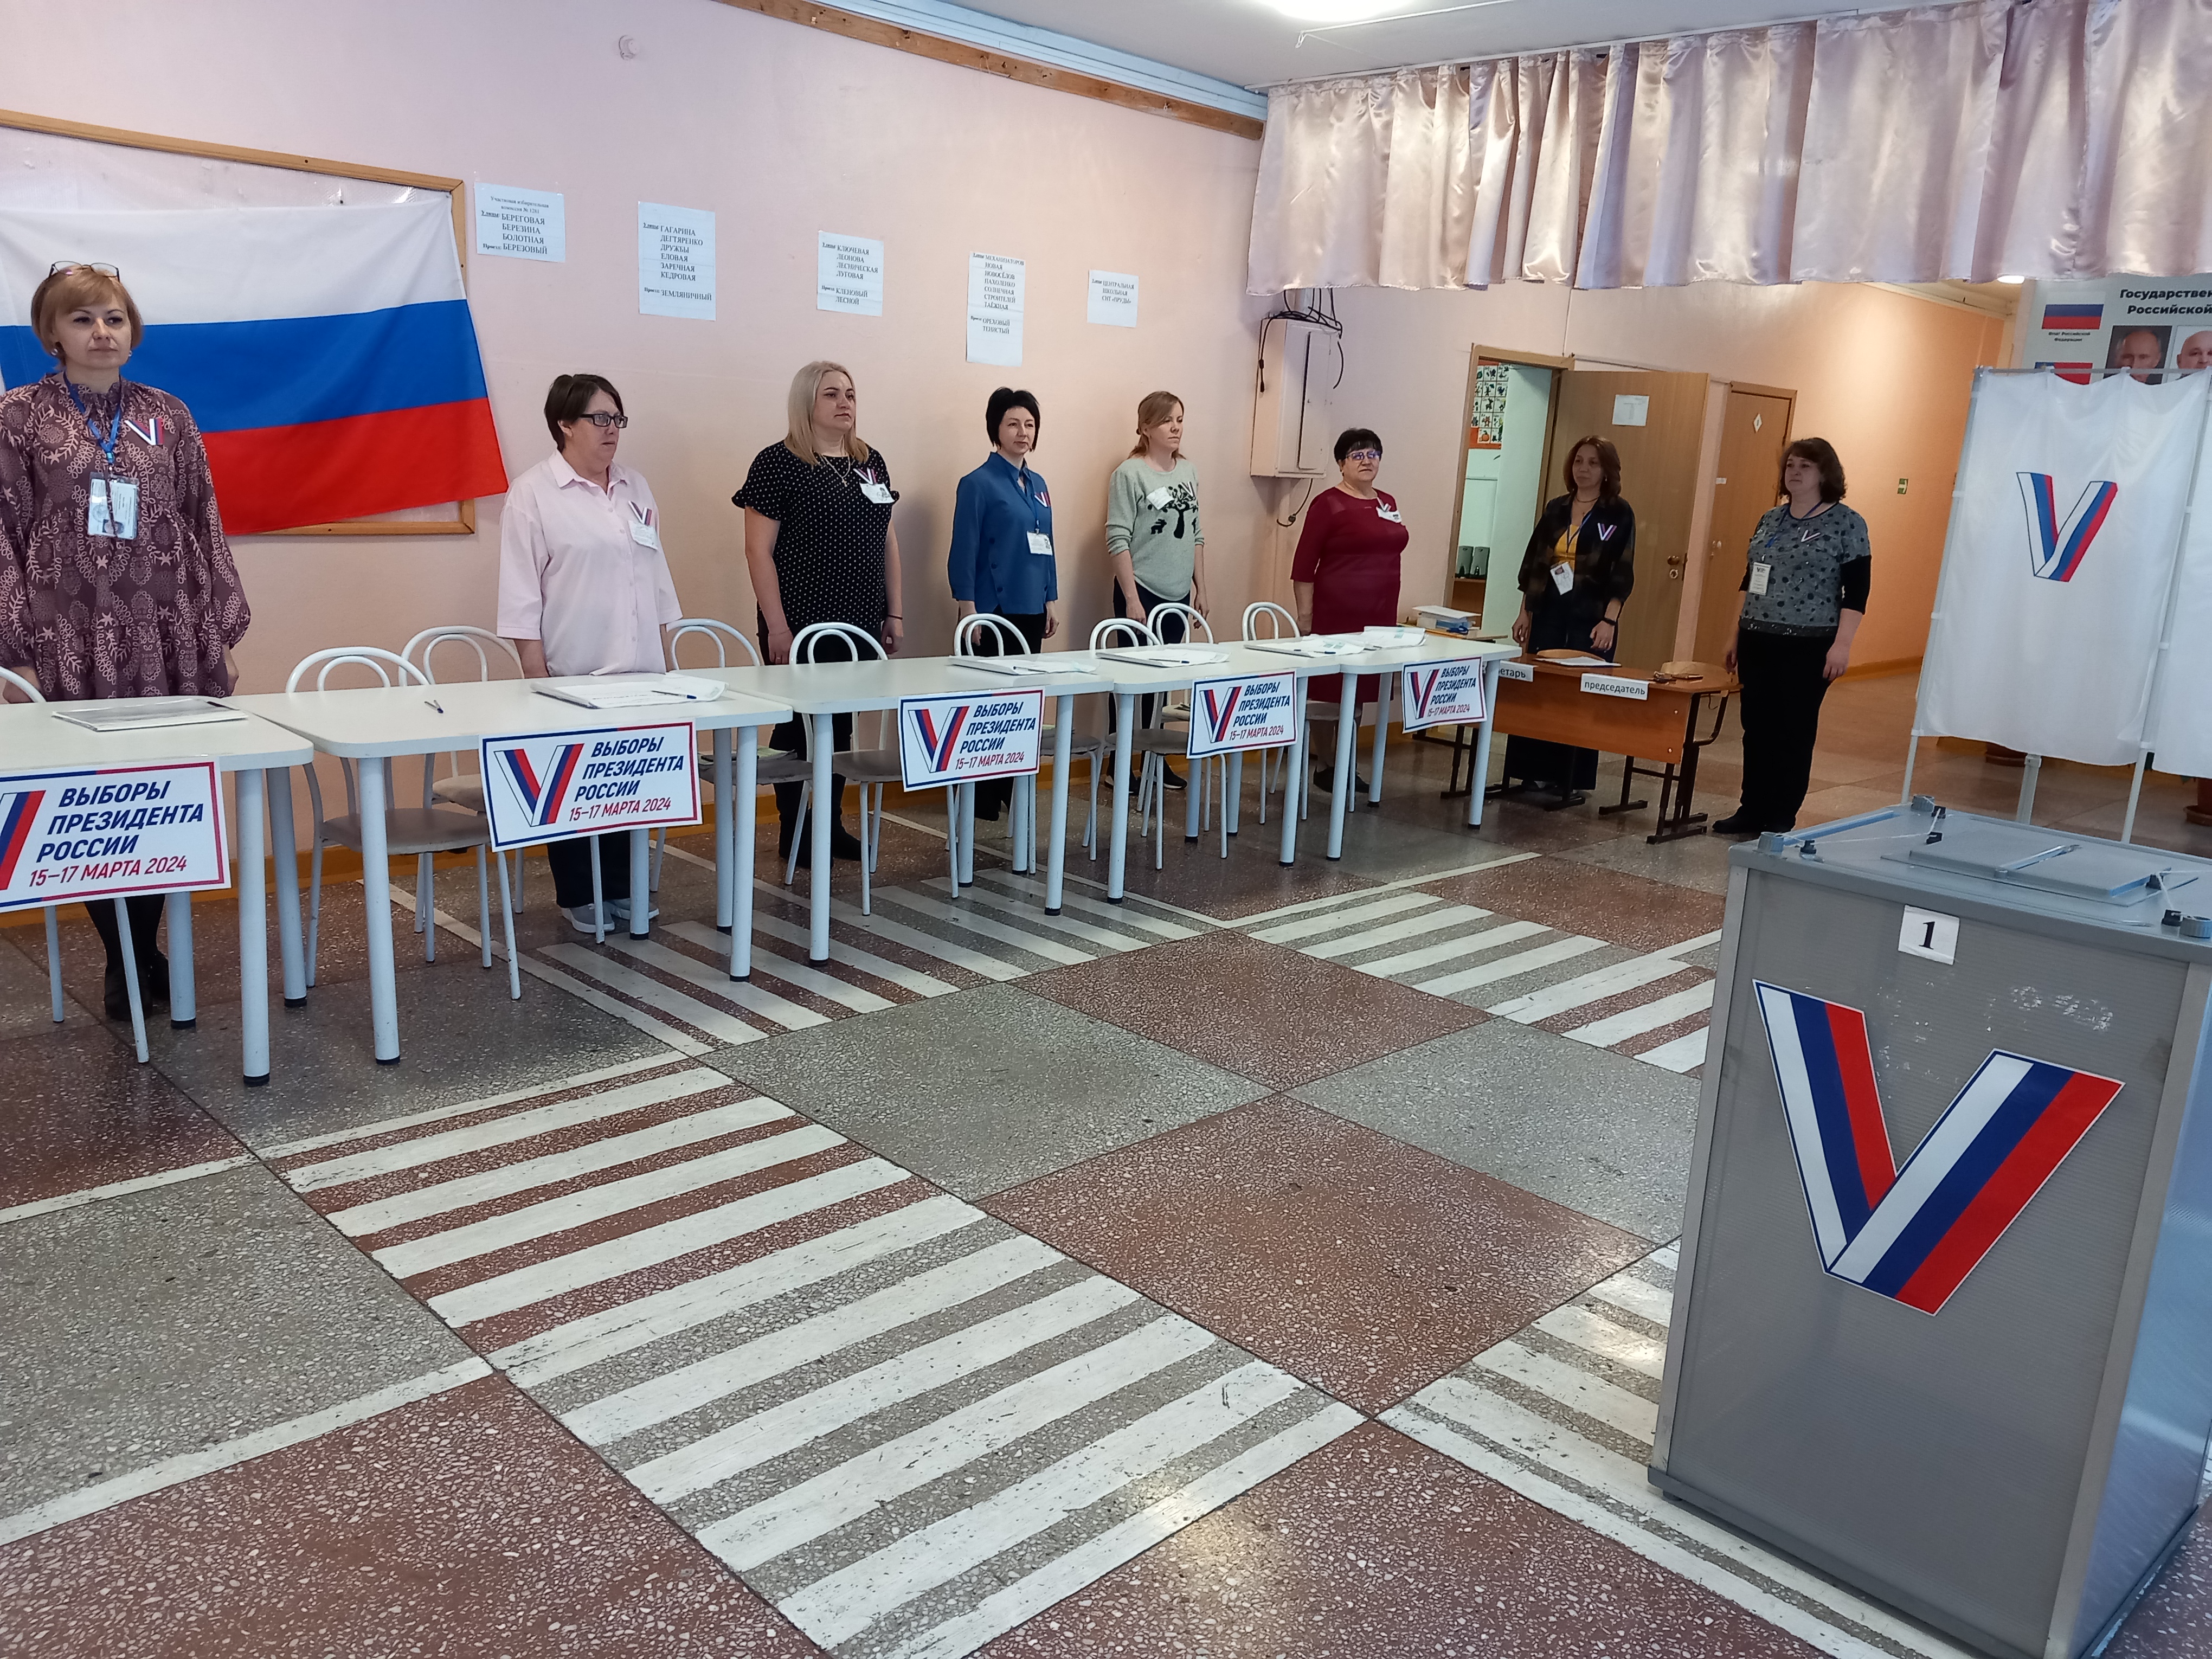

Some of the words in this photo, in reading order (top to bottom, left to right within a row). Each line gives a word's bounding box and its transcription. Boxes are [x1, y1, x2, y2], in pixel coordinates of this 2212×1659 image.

[501, 213, 545, 225] БЕРЕГОВАЯ
[502, 223, 541, 234] БЕРЕЗИНА
[660, 226, 696, 236] ГАГАРИНА
[503, 233, 544, 244] БОЛОТНАЯ
[660, 235, 703, 246] ДЕГТЯРЕНКО
[503, 243, 547, 254] БЕРЕЗОВЫЙ
[660, 244, 689, 253] ДРУЖБЫ
[837, 245, 869, 255] КЛЮЧЕВАЯ
[661, 253, 688, 262] ЕЛОВАЯ
[837, 253, 864, 263] ЛЕОНОВА
[661, 262, 695, 272] ЗАРЕЧНАЯ
[837, 262, 878, 273] ЛЕСНИЧЕСКАЯ
[985, 262, 1002, 270] НОВАЯ
[661, 272, 696, 281] КЕДРОВАЯ
[836, 271, 863, 279] ЛУГОВАЯ
[984, 286, 1014, 295] СОЛНЕЧНАЯ
[1103, 280, 1134, 290] ЦЕНТРАЛЬНАЯ
[661, 289, 712, 300] ЗЕМЛЯНИЧНЫЙ
[984, 294, 1015, 303] СТРОИТЕЛЕЙ
[835, 296, 859, 305] ЛЕСНОЙ
[2127, 304, 2212, 314] Российской
[982, 318, 1010, 326] ОРЕХОВЫЙ
[983, 326, 1009, 334] ТЕНИСТЫЙ
[1441, 665, 1470, 678] ВЫБОРЫ
[1244, 681, 1281, 696] ВЫБОРЫ
[1435, 678, 1476, 692] ПРЕЗИДЕНТА
[1584, 681, 1645, 696] председатель
[1238, 695, 1290, 712] ПРЕЗИДЕНТА
[1430, 692, 1457, 705] РОССИИ
[973, 702, 1024, 718] ВЫБОРЫ
[1438, 705, 1456, 715] МАРТА
[1456, 704, 1470, 713] 2024
[1233, 712, 1268, 728] РОССИИ
[966, 717, 1037, 736] ПРЕЗИДЕНТА
[1246, 726, 1268, 739] МАРТА
[1268, 725, 1284, 736] 2024
[591, 736, 665, 758] ВЫБОРЫ
[960, 737, 1006, 754] РОССИИ
[978, 753, 1005, 768] МАРТА
[1004, 751, 1025, 764] 2024
[582, 755, 684, 780] ПРЕЗИДЕНТА
[58, 780, 171, 808] ВЫБОРЫ
[574, 780, 641, 802] РОССИИ
[601, 800, 640, 817] МАРТА
[642, 797, 671, 812] 2024
[47, 803, 204, 835] ПРЕЗИДЕНТА
[36, 834, 140, 863] РОССИИ
[80, 859, 142, 881] МАРТА
[144, 855, 187, 874] 2024
[1918, 921, 1935, 950] 1
